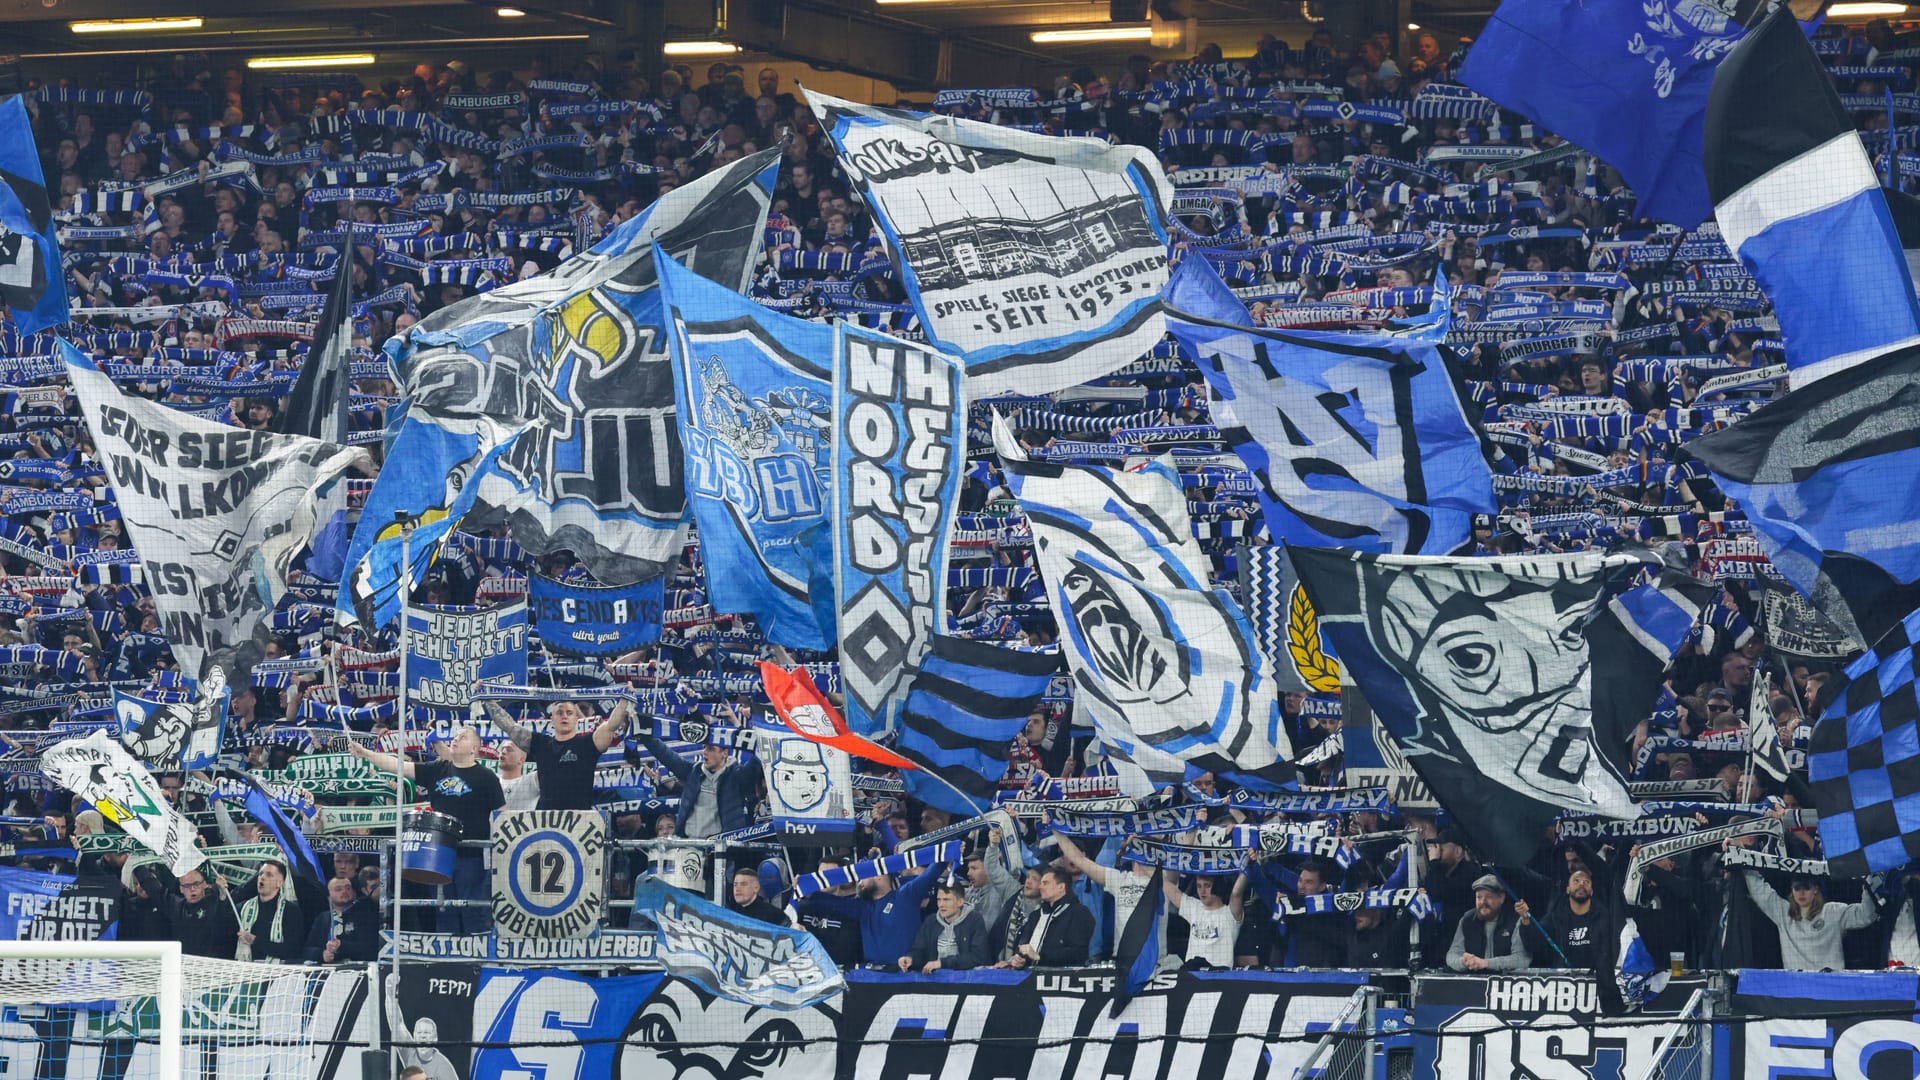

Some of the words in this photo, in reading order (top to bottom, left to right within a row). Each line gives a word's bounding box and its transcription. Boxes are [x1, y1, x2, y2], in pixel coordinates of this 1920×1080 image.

[1841, 96, 1909, 107] HAMBURER
[469, 190, 552, 206] HAMBURGER
[554, 187, 575, 201] SV
[934, 296, 998, 320] SPIELE,
[1001, 285, 1051, 310] SIEGE
[1069, 253, 1168, 300] EMOTIONEN
[1586, 272, 1617, 284] Nord
[1712, 279, 1756, 291] BOYS
[1066, 282, 1134, 322] 1953
[1573, 303, 1605, 314] Nord
[226, 320, 315, 337] HAMBURGER
[1264, 309, 1363, 328] HAMBURGER
[1368, 309, 1393, 320] SV
[1500, 336, 1577, 364] HAMBURGER
[1584, 336, 1603, 349] SV
[111, 365, 197, 377] HAMBURGER
[201, 366, 224, 377] S.V.
[1051, 443, 1126, 456] AMBURGER
[7, 493, 79, 509] HAMBURGER
[848, 339, 900, 577] NORD
[900, 344, 956, 703] HESSE
[76, 550, 136, 566] HAMBURG
[429, 610, 497, 637] JEDER
[407, 624, 524, 660] FEHLTRITT
[596, 629, 619, 646] youth
[442, 658, 480, 684] IST
[1695, 780, 1722, 792] SV
[1252, 788, 1322, 812] SUPER
[1326, 788, 1388, 810] HSV
[491, 810, 578, 856] SEKTION
[785, 820, 817, 835] hsv
[1055, 808, 1125, 835] SUPER
[1133, 808, 1196, 832] HSV
[1635, 826, 1743, 864] HAMBURGER
[1755, 818, 1780, 832] SV
[1134, 838, 1193, 871] SUPER
[1198, 849, 1246, 871] HSV
[524, 851, 565, 895] 12
[8, 892, 114, 921] FREIHEIT
[491, 890, 602, 941] KØBENHAVN
[16, 914, 58, 942] FÜR
[61, 921, 101, 942] DIE
[399, 934, 488, 958] SEKTION
[429, 978, 471, 997] PEPPI
